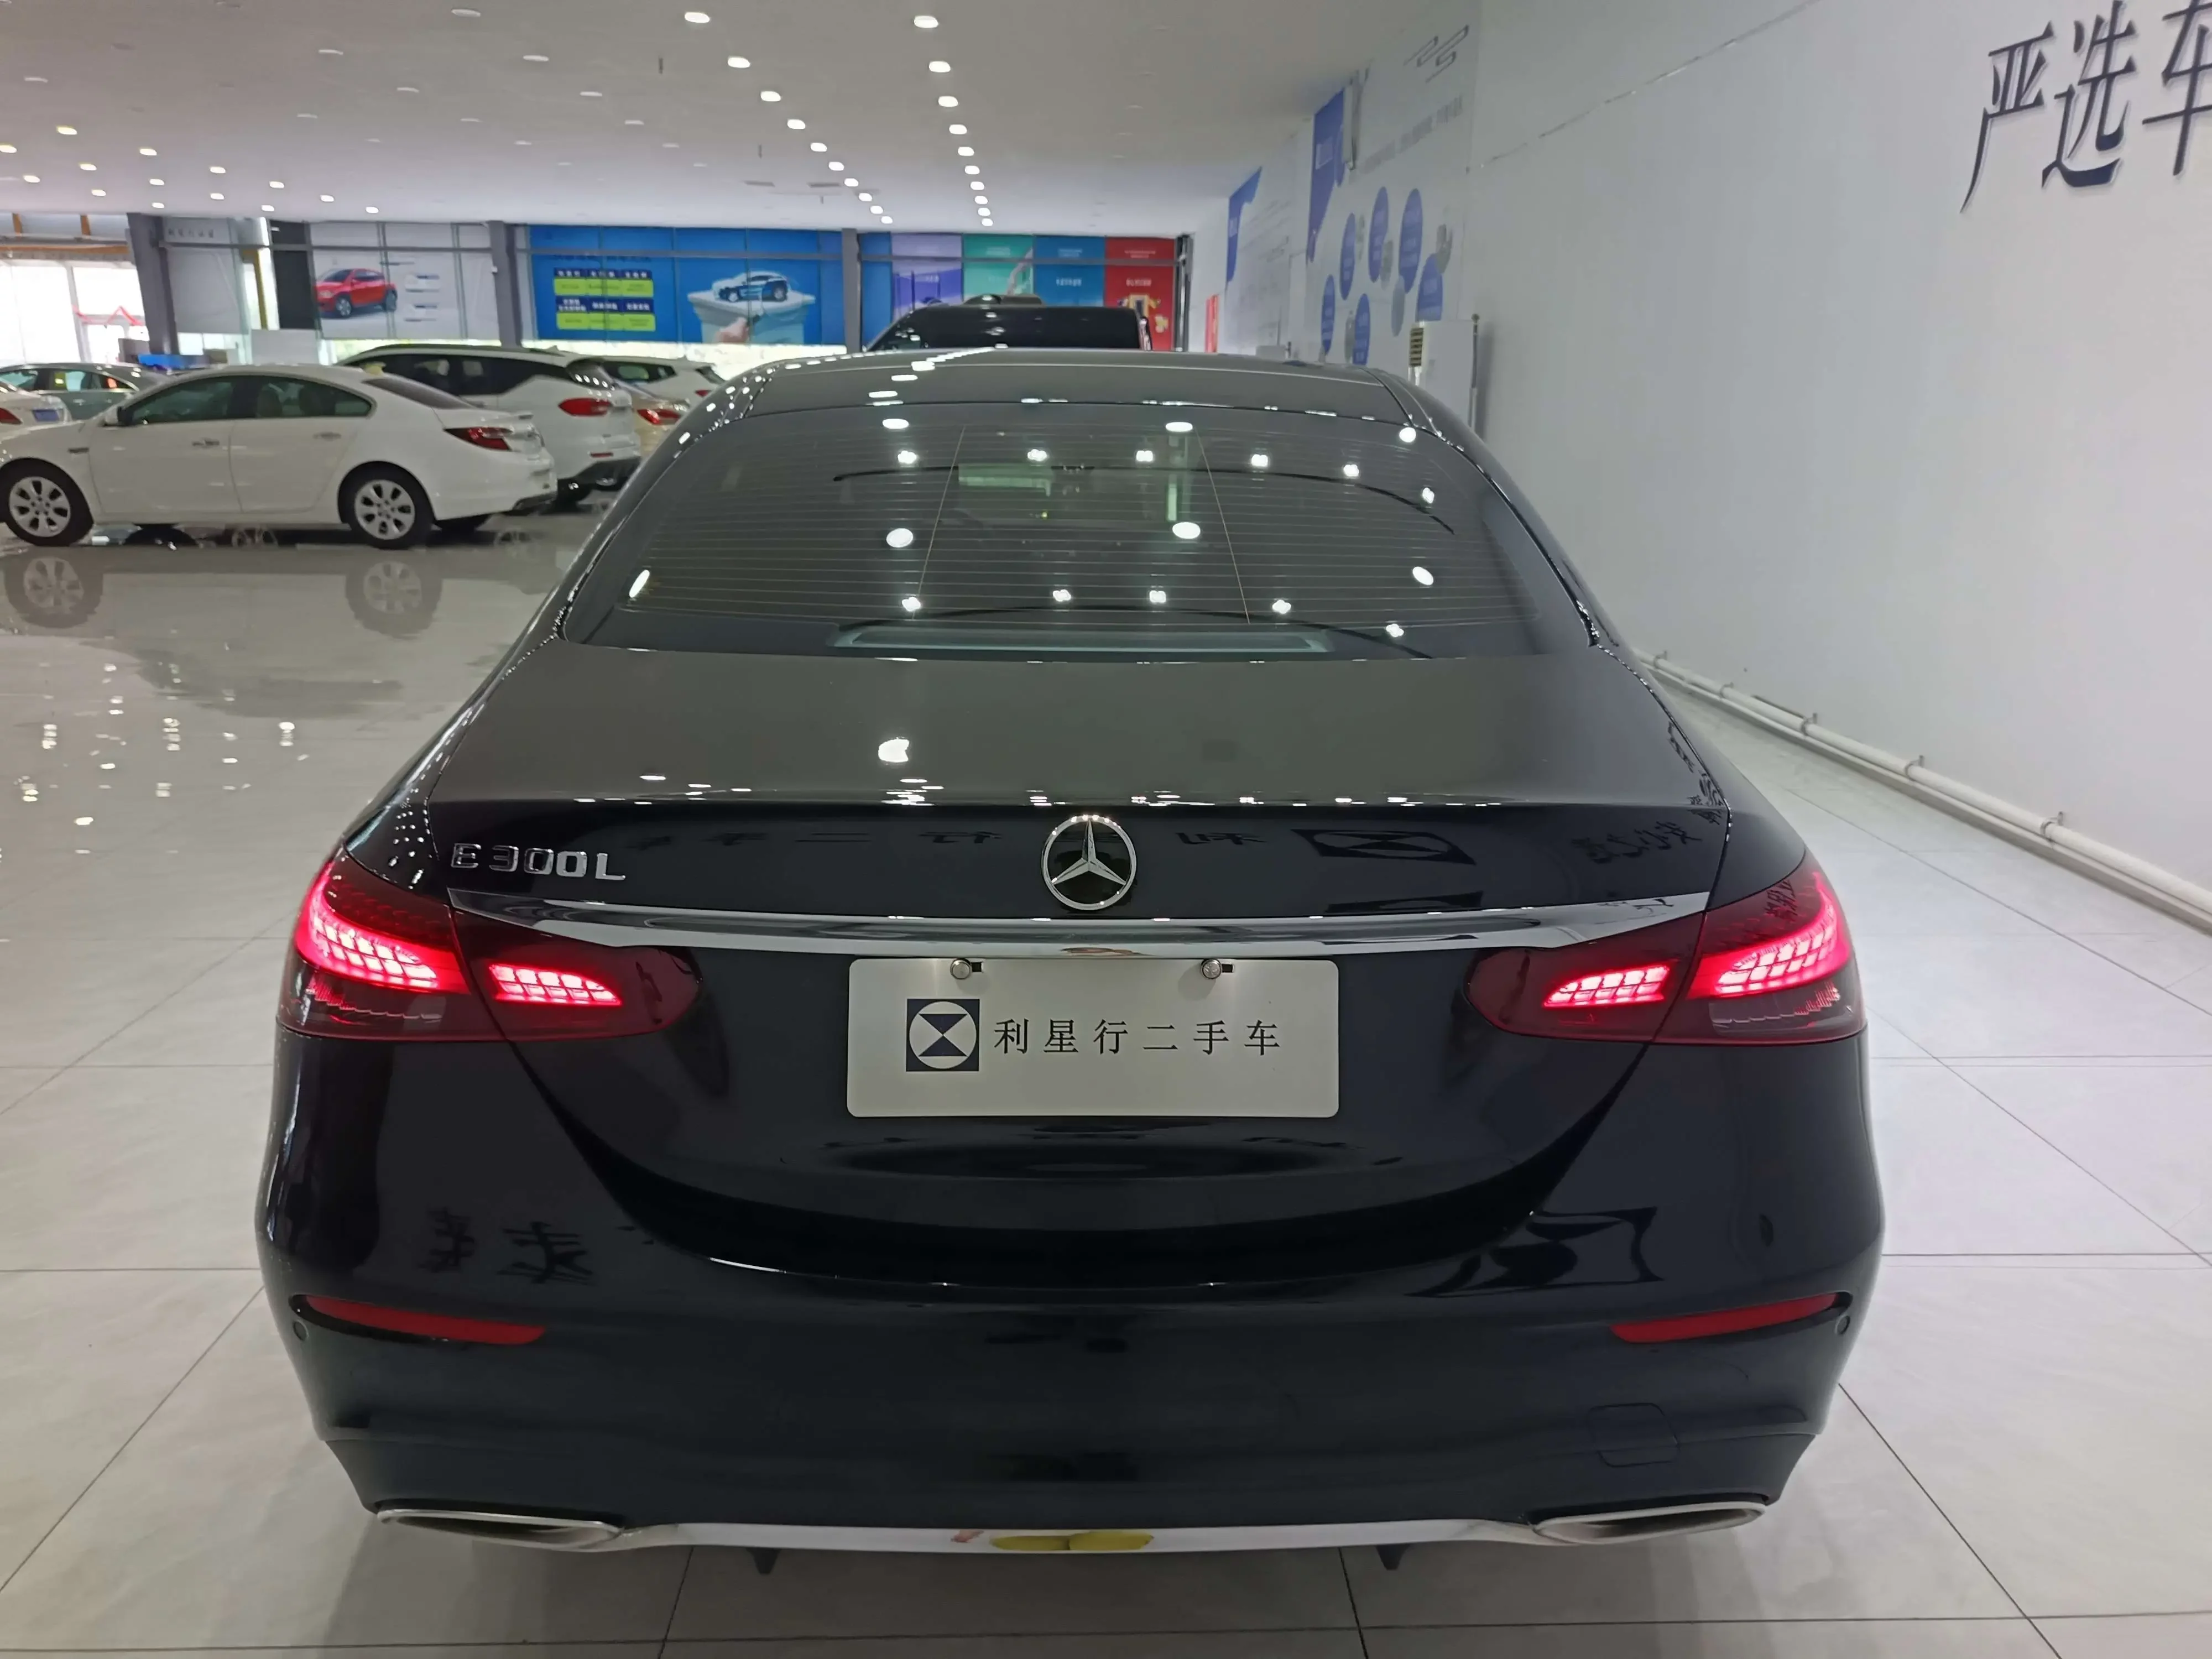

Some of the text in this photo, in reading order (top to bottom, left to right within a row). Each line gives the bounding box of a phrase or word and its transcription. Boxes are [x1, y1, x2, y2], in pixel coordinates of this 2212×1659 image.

[994, 1018, 1281, 1056] 利星行二手车
